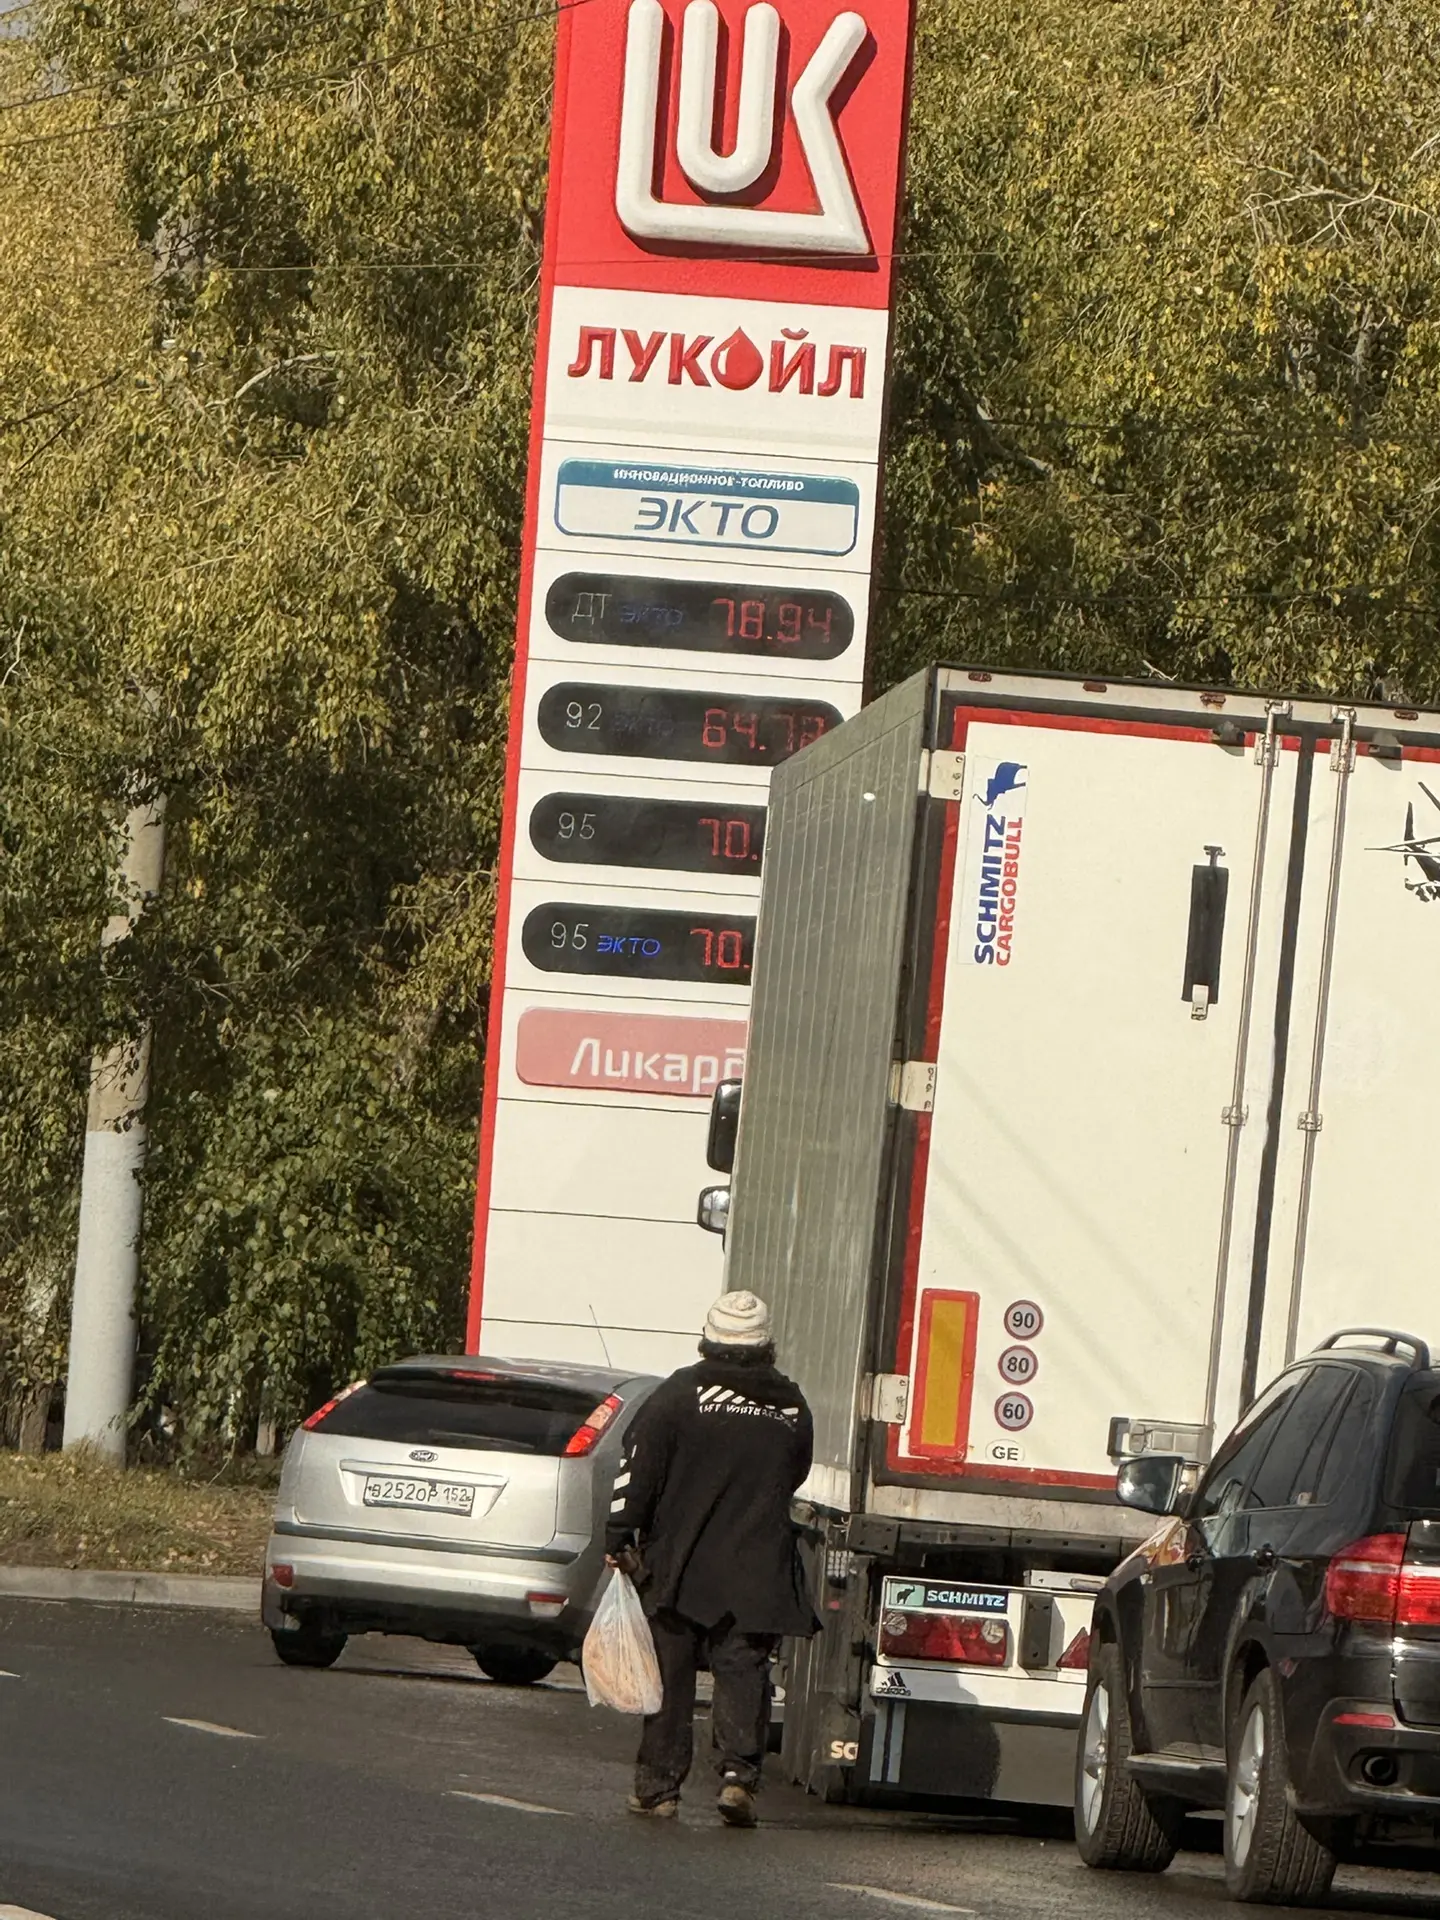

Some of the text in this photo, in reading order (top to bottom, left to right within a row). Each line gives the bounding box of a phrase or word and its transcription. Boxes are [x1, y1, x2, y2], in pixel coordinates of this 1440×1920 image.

[567, 324, 867, 399] ЛУКОЙЛ
[634, 497, 780, 540] ЭКТО
[571, 592, 613, 626] ДТ
[711, 597, 832, 644] 78.94
[565, 701, 603, 731] 92
[557, 812, 597, 840] 95
[974, 814, 1007, 965] SCHMITZ
[996, 817, 1023, 966] CARGOBULL
[550, 921, 590, 951] 95
[596, 935, 662, 957] ЭКТО
[1012, 1311, 1035, 1329] 90
[1006, 1356, 1030, 1374] 80
[1002, 1402, 1025, 1420] 60
[992, 1446, 1019, 1461] GE
[927, 1589, 1007, 1608] SCHMITZ
